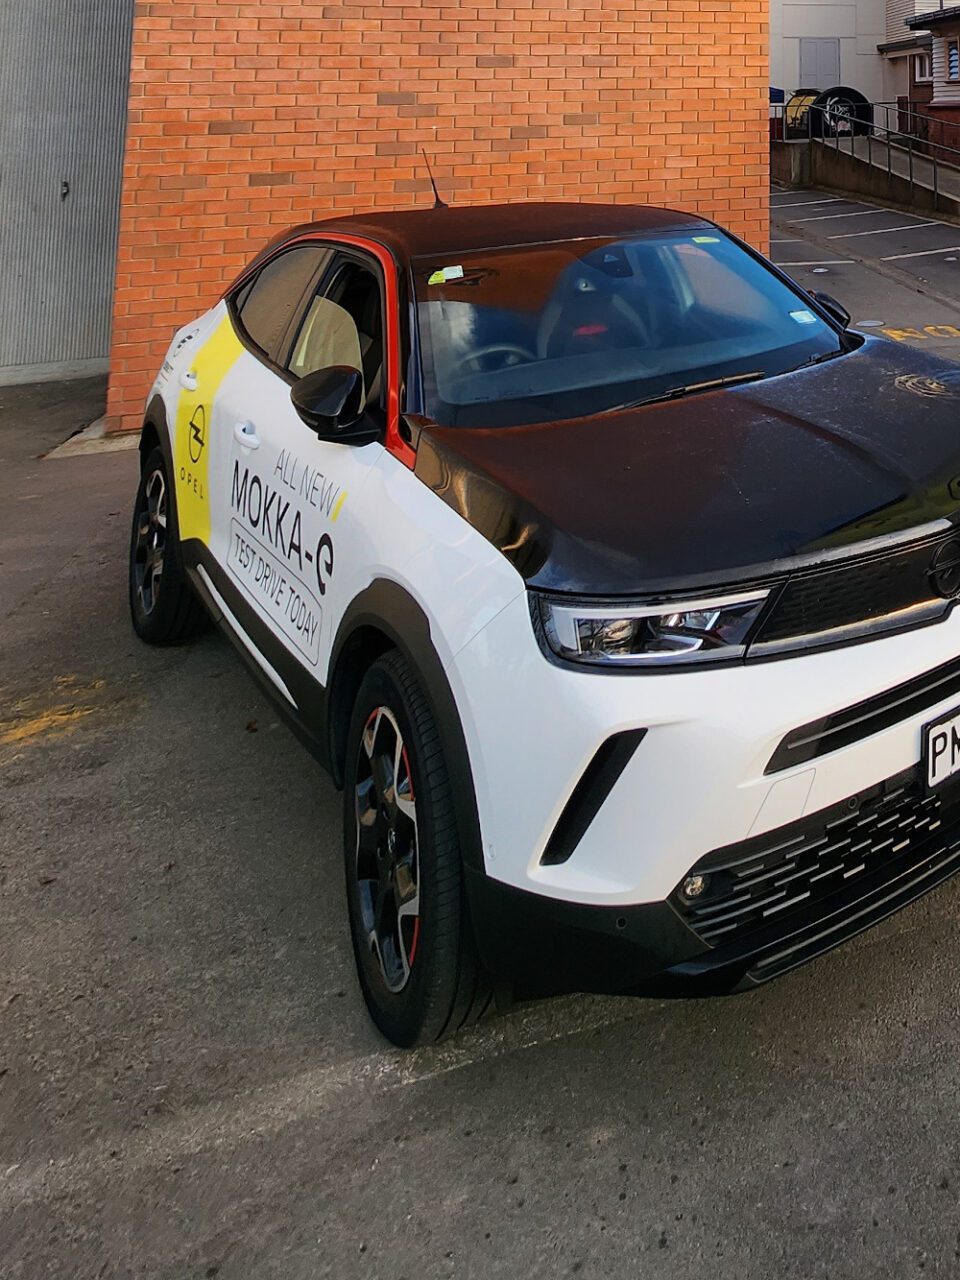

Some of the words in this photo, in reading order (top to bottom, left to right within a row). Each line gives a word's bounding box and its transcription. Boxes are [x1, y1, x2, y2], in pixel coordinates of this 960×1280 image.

[180, 466, 204, 500] OPEL
[274, 448, 296, 490] ALL
[301, 465, 340, 518] NEW
[234, 532, 257, 572] TEST
[254, 559, 287, 608] DRIVE
[284, 585, 319, 648] TODAY
